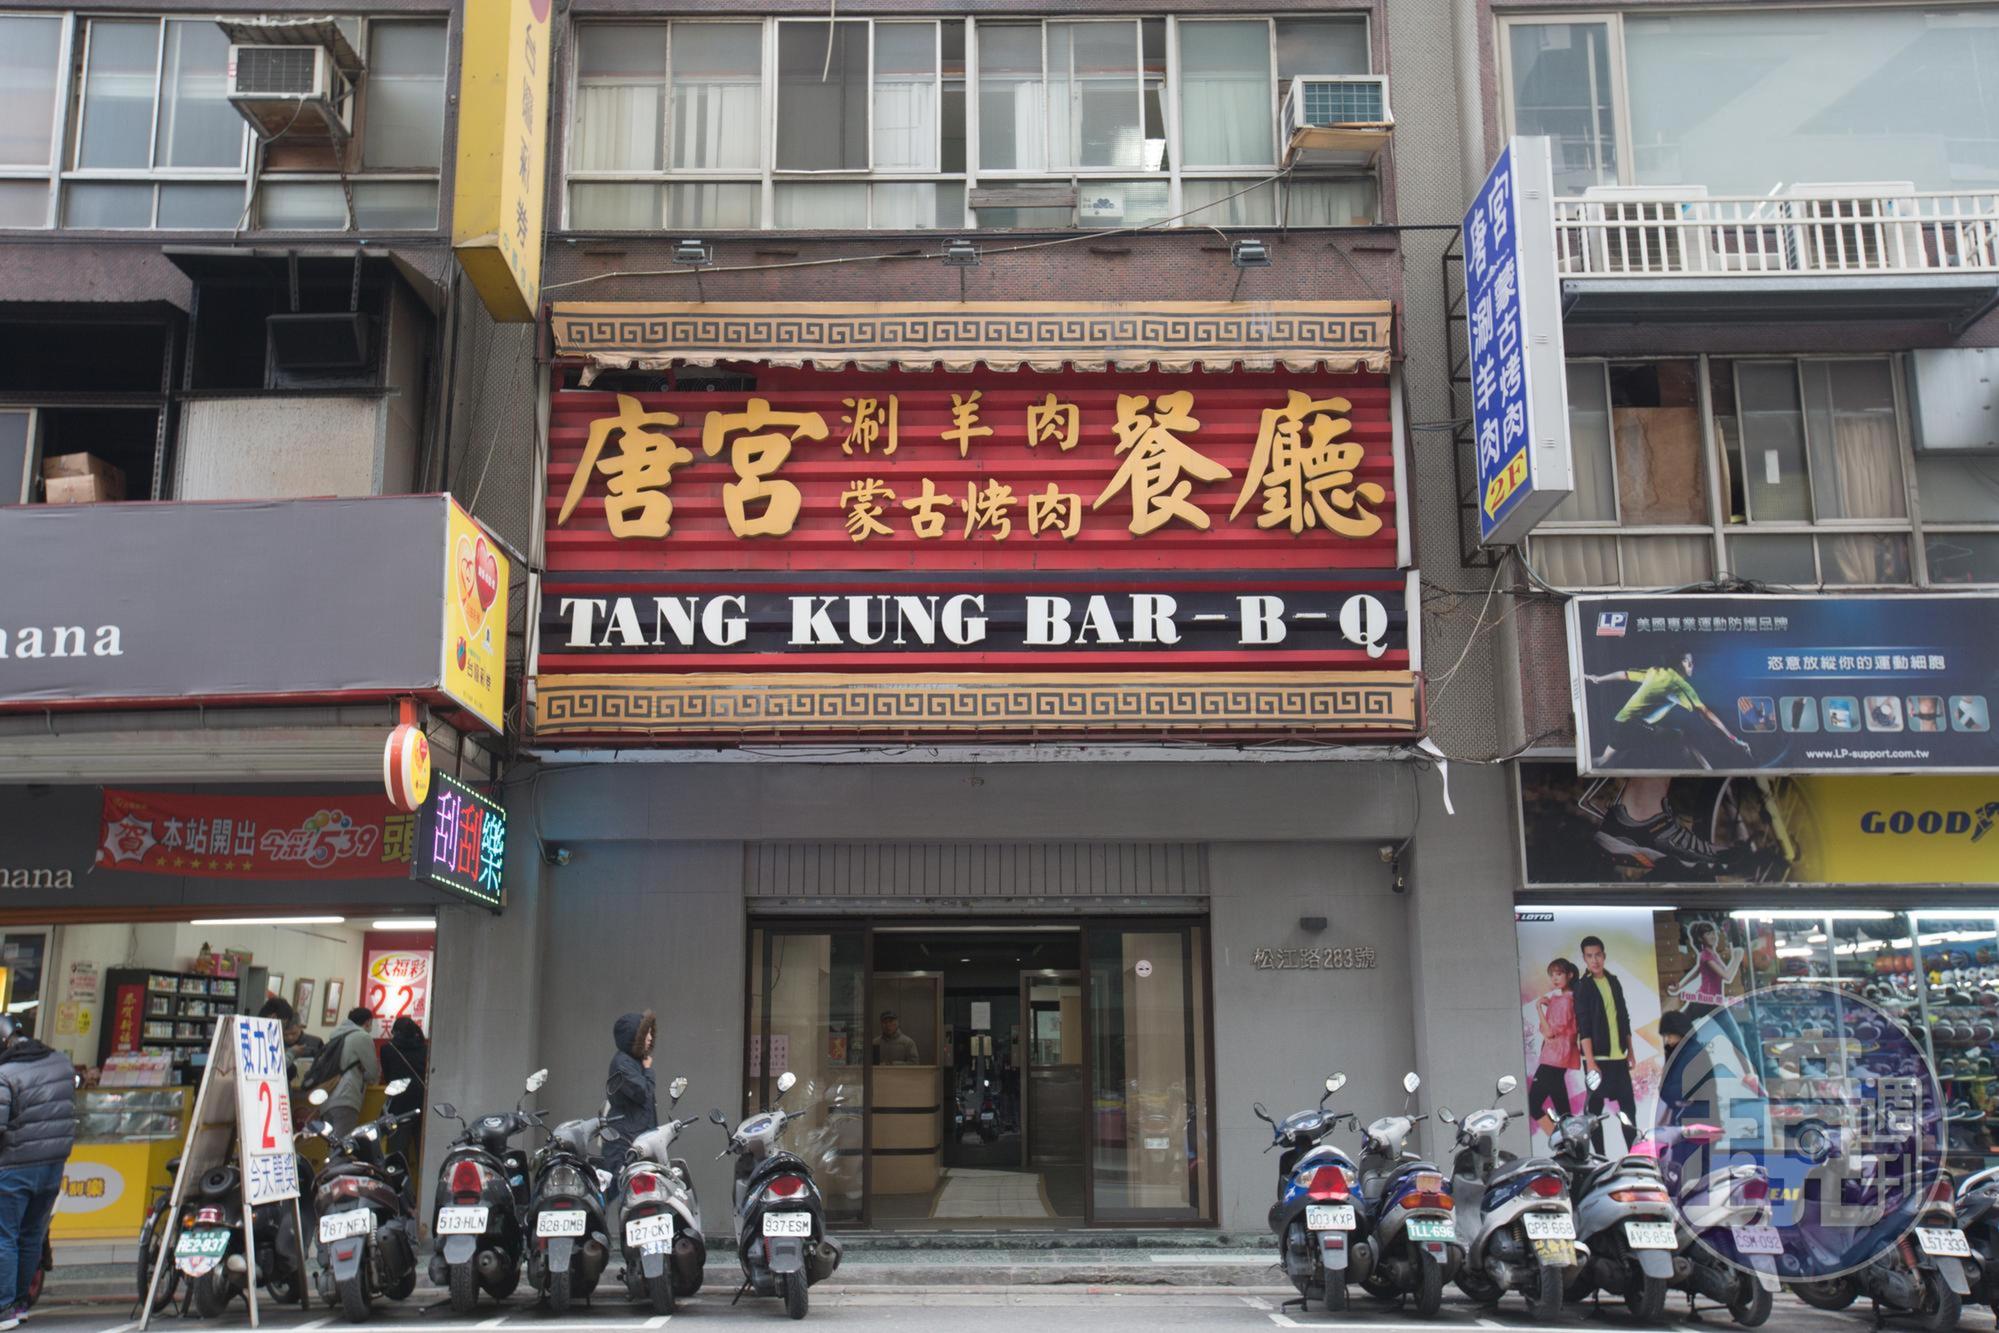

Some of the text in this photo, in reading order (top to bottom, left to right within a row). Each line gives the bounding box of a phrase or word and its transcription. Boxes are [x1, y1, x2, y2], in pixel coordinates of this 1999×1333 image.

[1493, 255, 1525, 455] 蒙古烤肉
[1472, 288, 1501, 479] 涮羊肉
[841, 390, 1080, 459] 涮羊肉
[557, 393, 829, 540] 唐宮
[1093, 389, 1386, 538] 餐廳
[1489, 452, 1527, 510] 2F
[839, 477, 1082, 543] 蒙古烤肉
[0, 623, 124, 659] ana
[559, 593, 1388, 659] TANG KUNG BAR-B-Q
[1600, 613, 1625, 628] LP
[1767, 655, 1946, 671] 恣意放縱你的運動細胞
[1806, 748, 1930, 760] www.LP-support.com.tw
[161, 816, 256, 856] 本站開出
[433, 790, 505, 890] 刮刮樂
[1860, 811, 1971, 834] GOOD
[1254, 947, 1375, 969] 松江路283號
[369, 983, 413, 1018] 2.2
[240, 1020, 285, 1075] 威力彩
[259, 1081, 276, 1149] 2
[440, 1216, 486, 1228] 513-HLN
[629, 1222, 671, 1242] 127-CKY
[765, 1219, 809, 1232] 937-ESM
